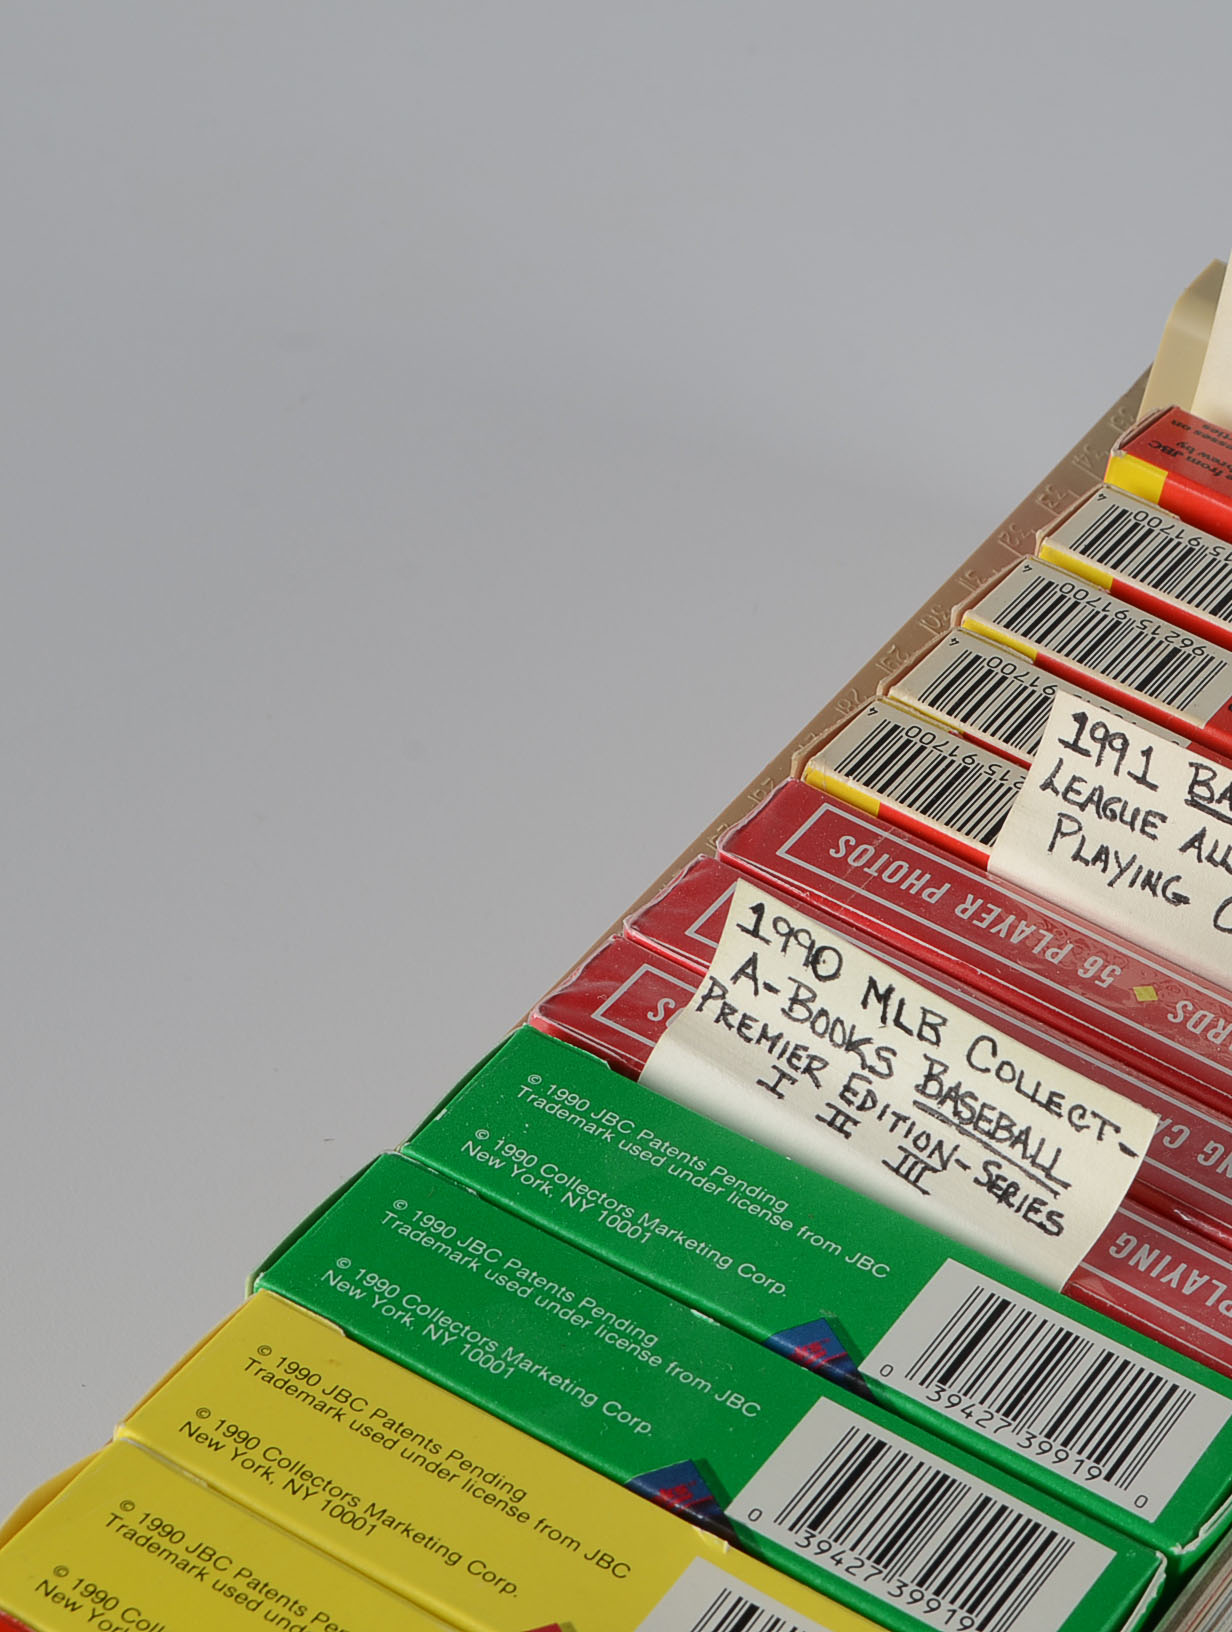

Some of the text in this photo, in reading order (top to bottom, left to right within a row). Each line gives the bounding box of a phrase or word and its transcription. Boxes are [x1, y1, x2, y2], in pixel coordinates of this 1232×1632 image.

[1149, 441, 1184, 456] JBC
[1186, 456, 1223, 476] from
[1133, 511, 1202, 546] 91700
[1059, 583, 1206, 656] 96215 91700
[986, 657, 1058, 695] 91700
[905, 726, 978, 769] 91700
[1057, 711, 1160, 793] 1991
[1039, 759, 1166, 840] LEAGUE
[830, 836, 951, 904] PHOTOS
[1050, 816, 1190, 907] PLAYING
[955, 894, 1074, 964] PLAYER
[1078, 956, 1121, 988] 56
[695, 975, 832, 1090] PREMIER
[732, 952, 1070, 1179] A-BOOKS BASEBALL
[736, 903, 843, 983] 1990
[862, 974, 949, 1048] MLB
[967, 1035, 1139, 1156] COLLECT-
[461, 1141, 651, 1243] New York, NY 10001
[518, 1085, 890, 1277] Trademark used under license from JBC
[547, 1085, 789, 1213] 1990 JBC Patents Pending
[494, 1140, 786, 1296] 1990 Collectors Marketing Corp.
[321, 1270, 514, 1378] New York, NY 10001
[382, 1211, 760, 1416] Trademark used under license from JBC
[413, 1211, 658, 1348] 1990 JBC Patents Pending
[356, 1269, 651, 1436] 1990 Collectors Marketing Corp.
[179, 1421, 376, 1536] New York, NY 10001
[245, 1357, 630, 1578] Trademark used under license from JBC
[276, 1357, 527, 1503] 1990 JBC Patents Pending
[925, 1384, 1103, 1482] 39427 39919
[215, 1420, 516, 1597] 1990 Collectors Marketing Corp.
[35, 1580, 83, 1612] New
[72, 1579, 119, 1611] 1990
[106, 1513, 264, 1612] Trademark used
[139, 1513, 307, 1616] 1990 JBC Patents
[795, 1532, 976, 1631] 39427 39919
